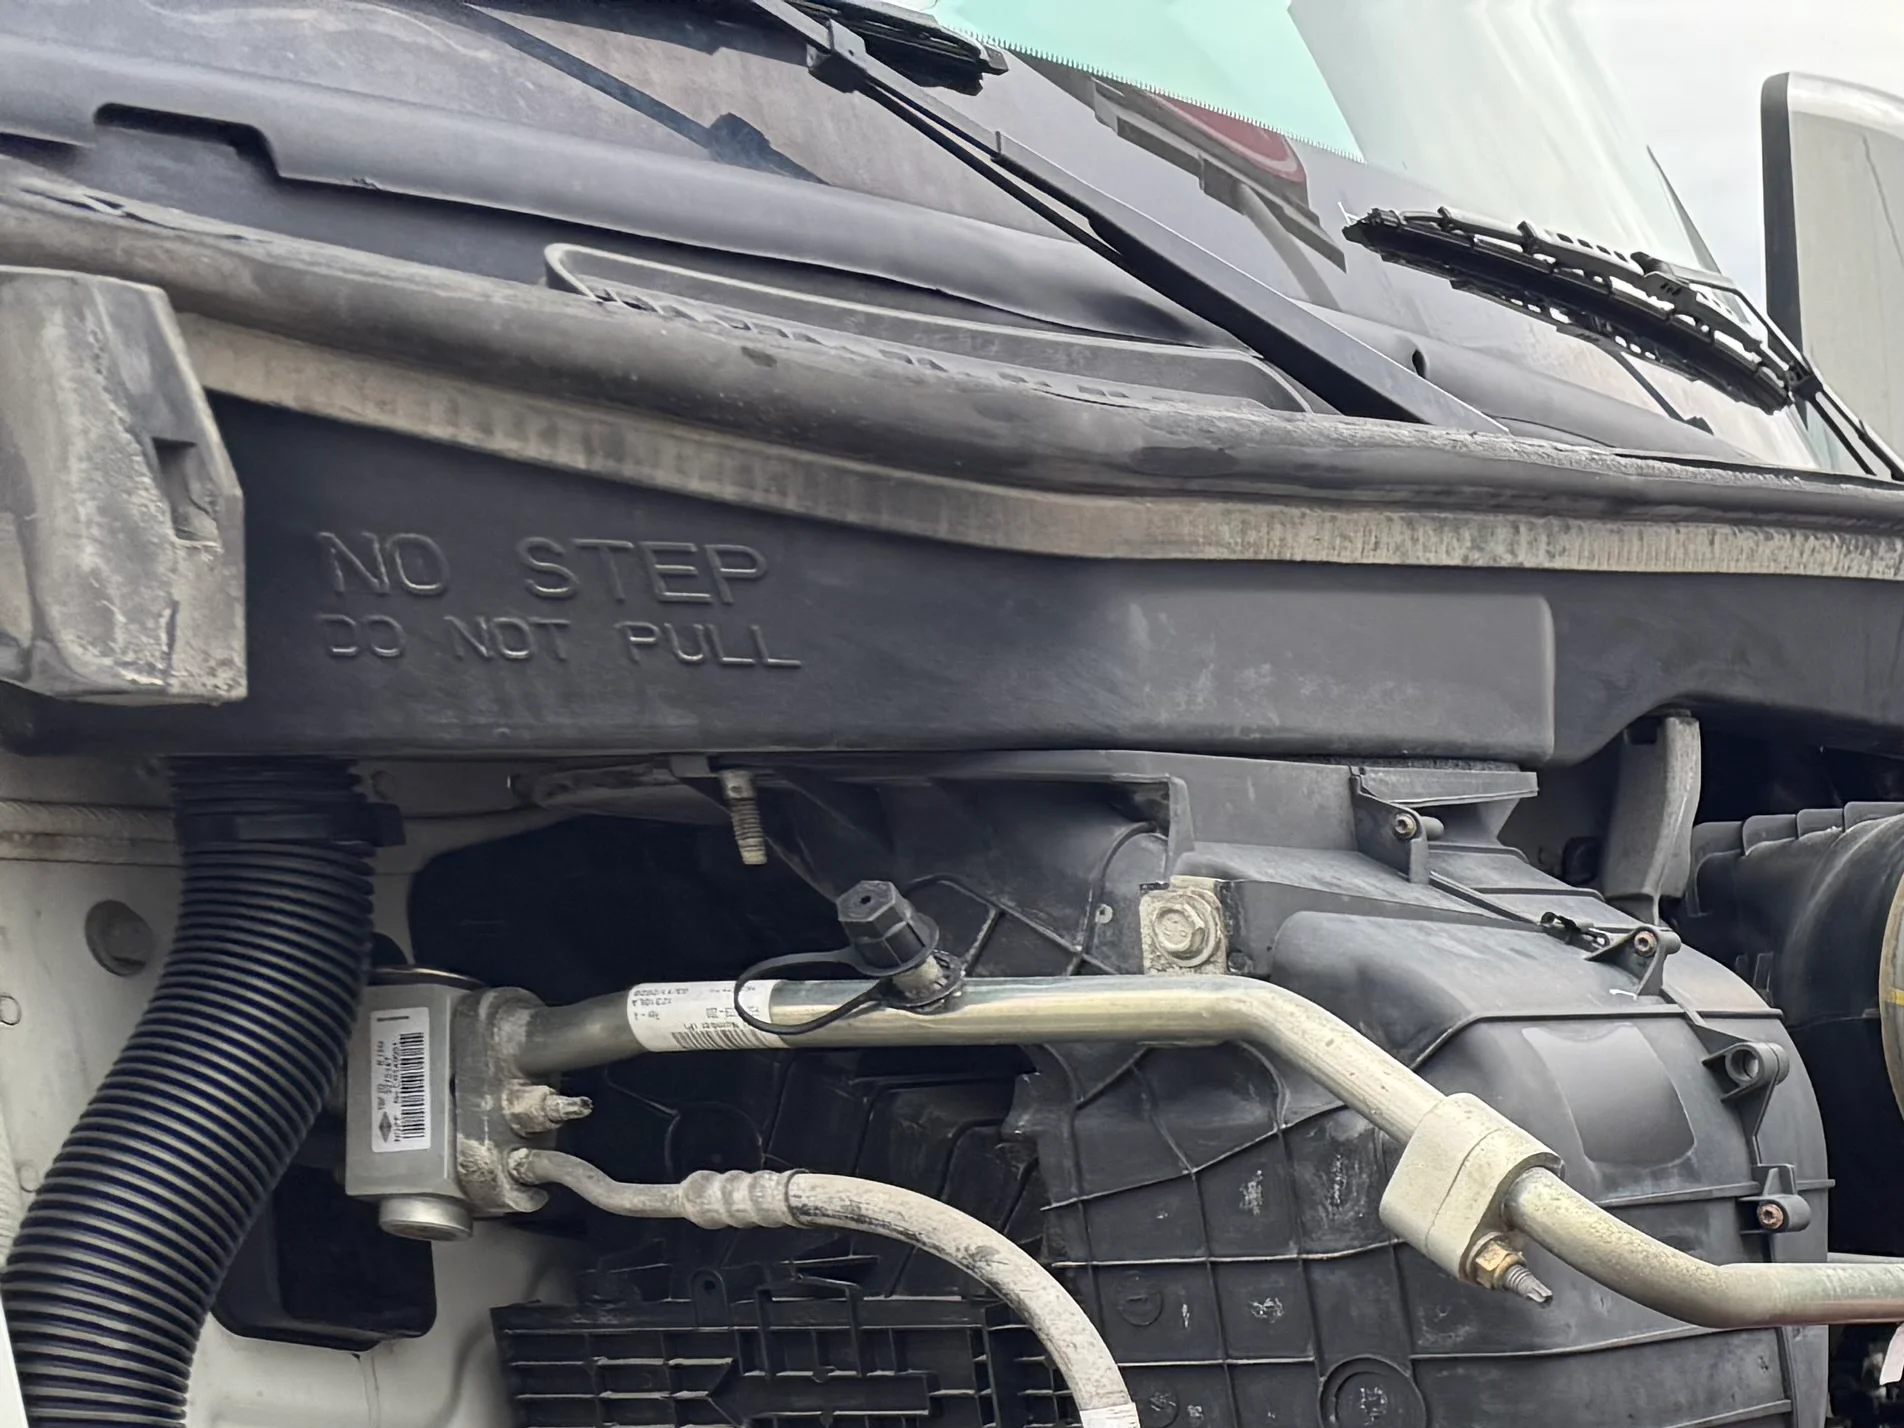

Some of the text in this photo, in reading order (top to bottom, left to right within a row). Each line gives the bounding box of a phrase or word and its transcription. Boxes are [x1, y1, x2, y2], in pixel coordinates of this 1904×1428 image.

[317, 530, 768, 605] NO STEP
[316, 613, 802, 668] DO NOT PULL
